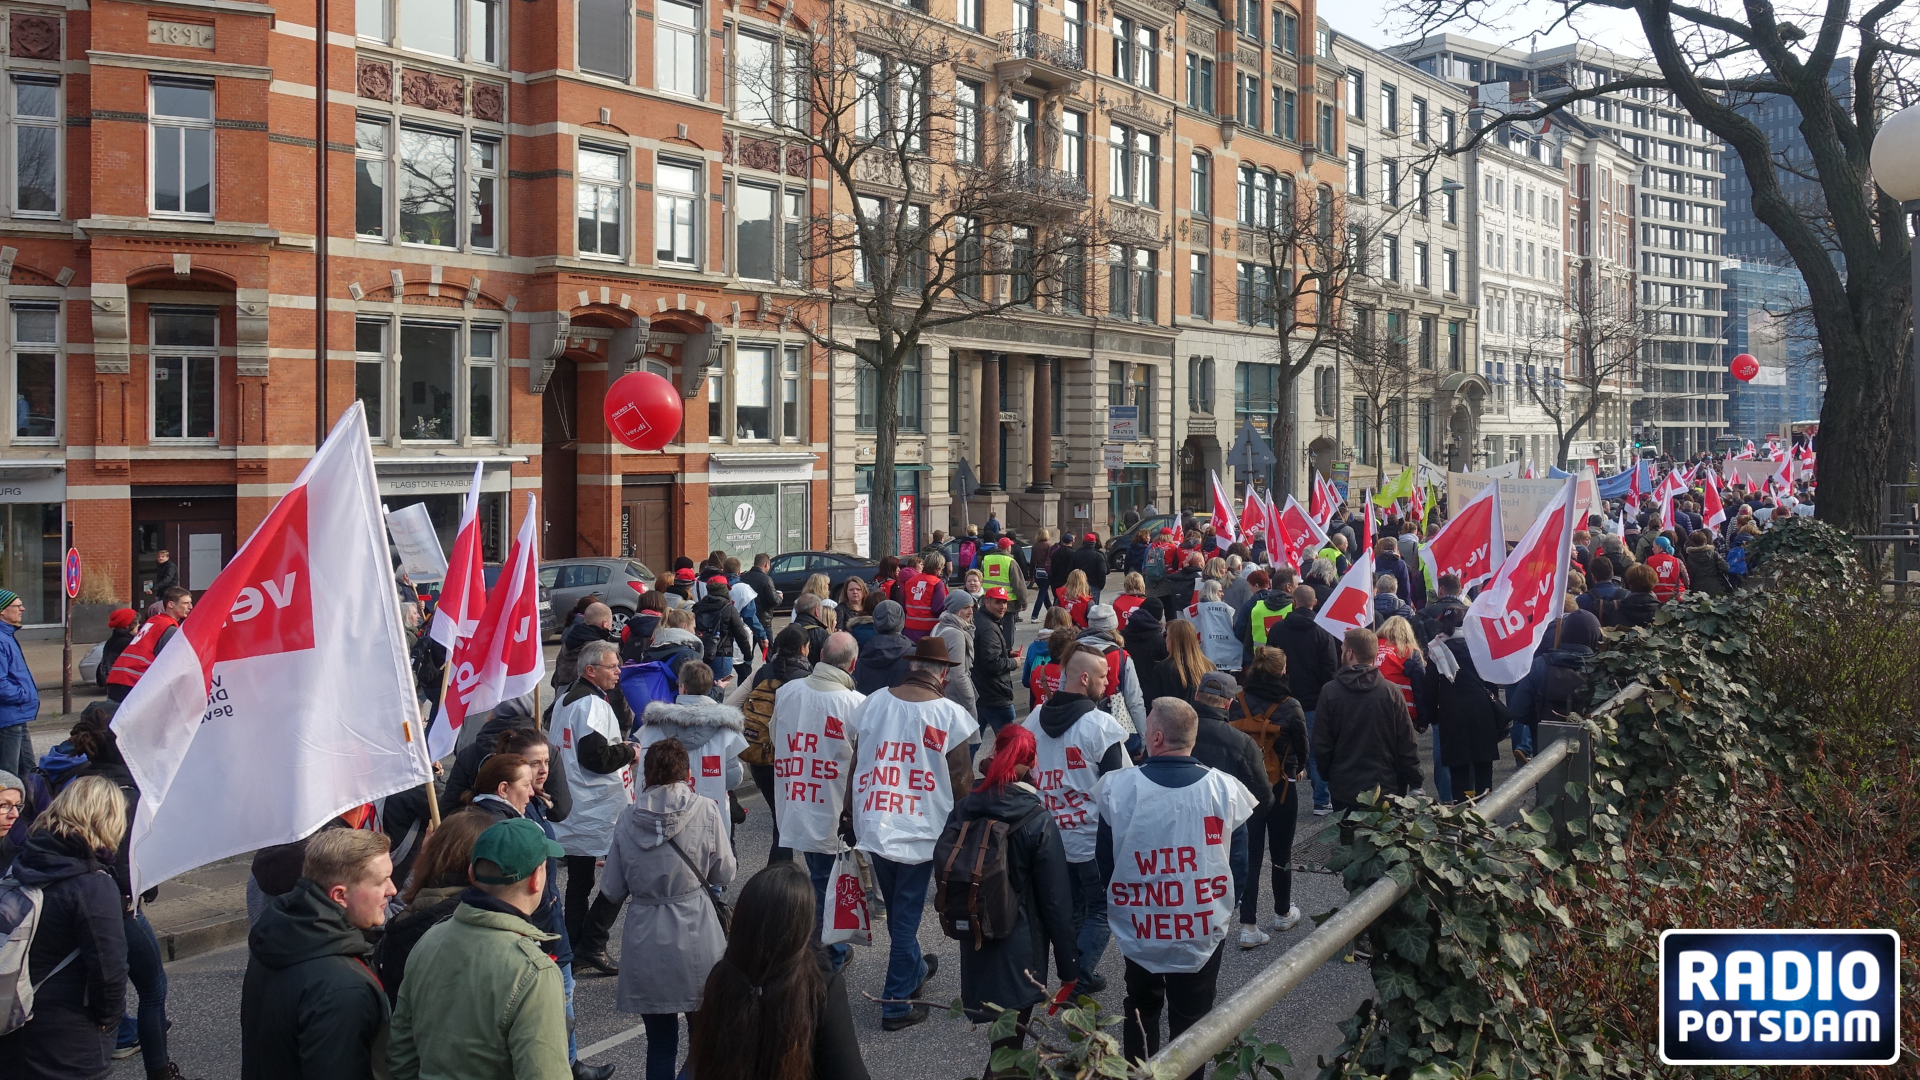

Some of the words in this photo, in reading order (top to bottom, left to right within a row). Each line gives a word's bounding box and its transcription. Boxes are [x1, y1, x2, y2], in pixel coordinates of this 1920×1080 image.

[160, 23, 204, 46] 1891
[625, 423, 647, 436] ver.di
[390, 480, 439, 489] FLAGSTONE
[440, 479, 474, 488] HAMBUR
[1656, 565, 1674, 574] GEW
[910, 586, 927, 595] GEW
[1208, 605, 1228, 613] STREIK
[924, 737, 942, 751] ver.di
[874, 741, 917, 764] WIR
[702, 767, 720, 775] ver.di
[811, 758, 839, 780] ES
[857, 766, 902, 793] SIND
[908, 769, 937, 792] ES
[1134, 846, 1198, 876] WIR
[1111, 880, 1184, 907] SIND
[1194, 875, 1228, 905] ES
